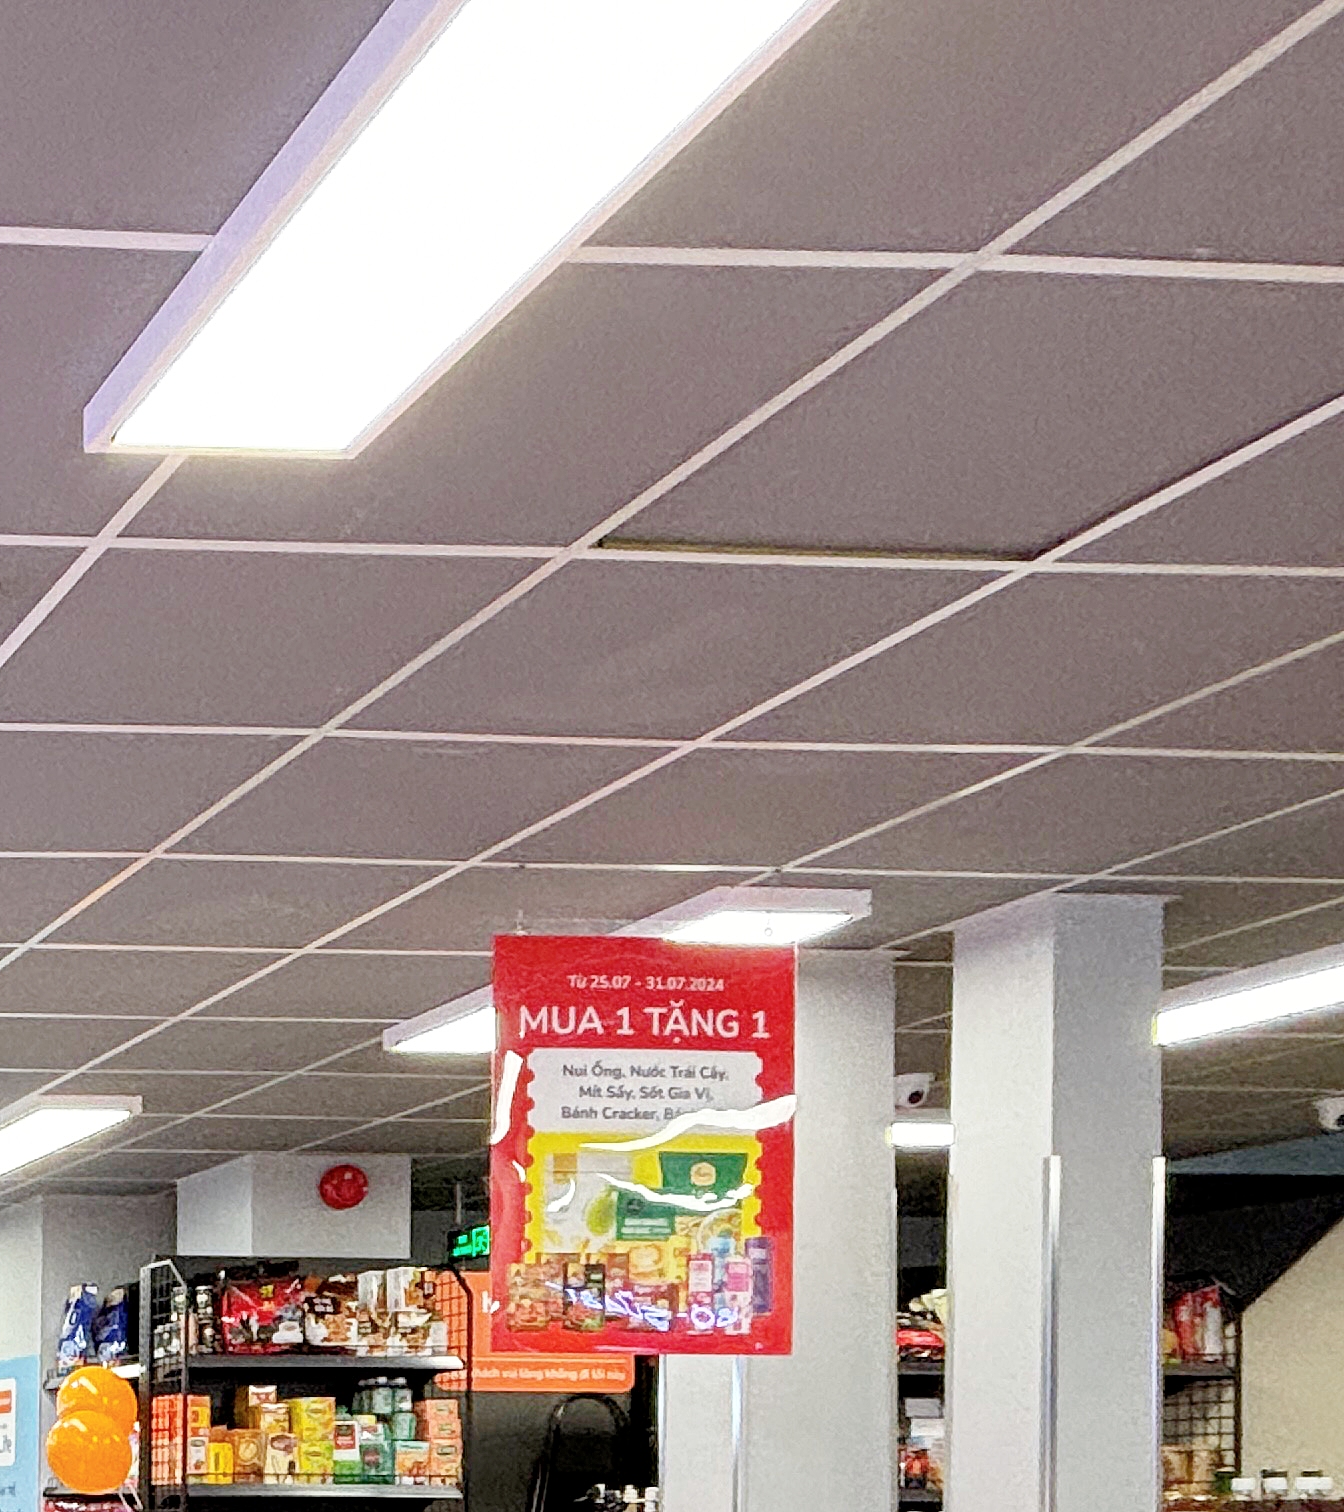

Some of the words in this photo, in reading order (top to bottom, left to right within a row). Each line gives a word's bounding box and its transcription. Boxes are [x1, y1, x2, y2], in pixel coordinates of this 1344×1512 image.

[567, 973, 588, 988] Từ
[590, 975, 631, 990] 25.07
[646, 976, 725, 992] 31.07.2024
[519, 1005, 604, 1038] MUA
[616, 1006, 635, 1036] 1
[643, 999, 740, 1043] TẶNG
[752, 1010, 771, 1039] 1
[563, 1065, 588, 1077] Nui
[630, 1064, 666, 1078] Nước
[670, 1065, 696, 1079] Trái
[578, 1086, 603, 1098] Mít
[668, 1088, 691, 1100] Gia
[561, 1107, 598, 1120] Bánh
